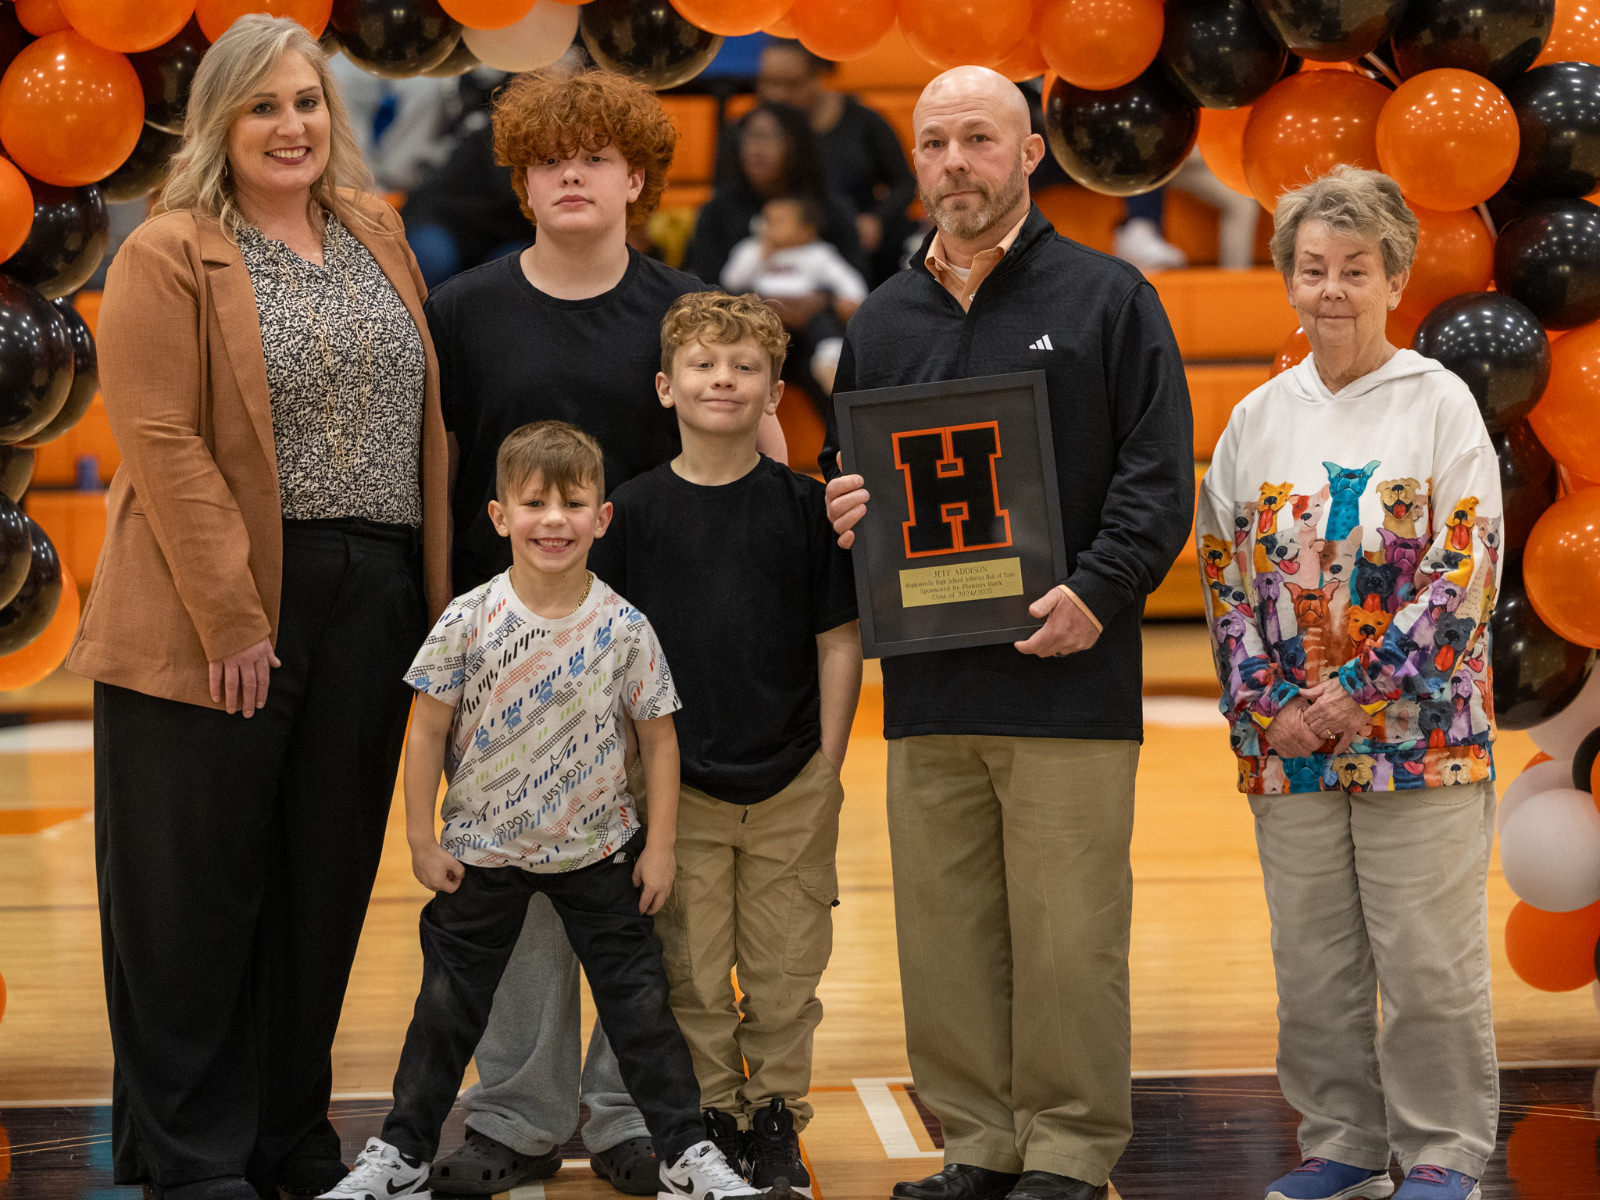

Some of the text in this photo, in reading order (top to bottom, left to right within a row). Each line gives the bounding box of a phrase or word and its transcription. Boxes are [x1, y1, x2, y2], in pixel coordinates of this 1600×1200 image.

[891, 421, 1013, 559] H
[933, 566, 988, 577] JEFF ADDISON
[469, 655, 486, 676] JUST
[647, 704, 662, 720] JUS
[596, 733, 617, 754] JUST
[542, 759, 587, 804] JUST DO IT.
[493, 809, 535, 837] JUST DO IT.
[455, 833, 472, 845] DO
